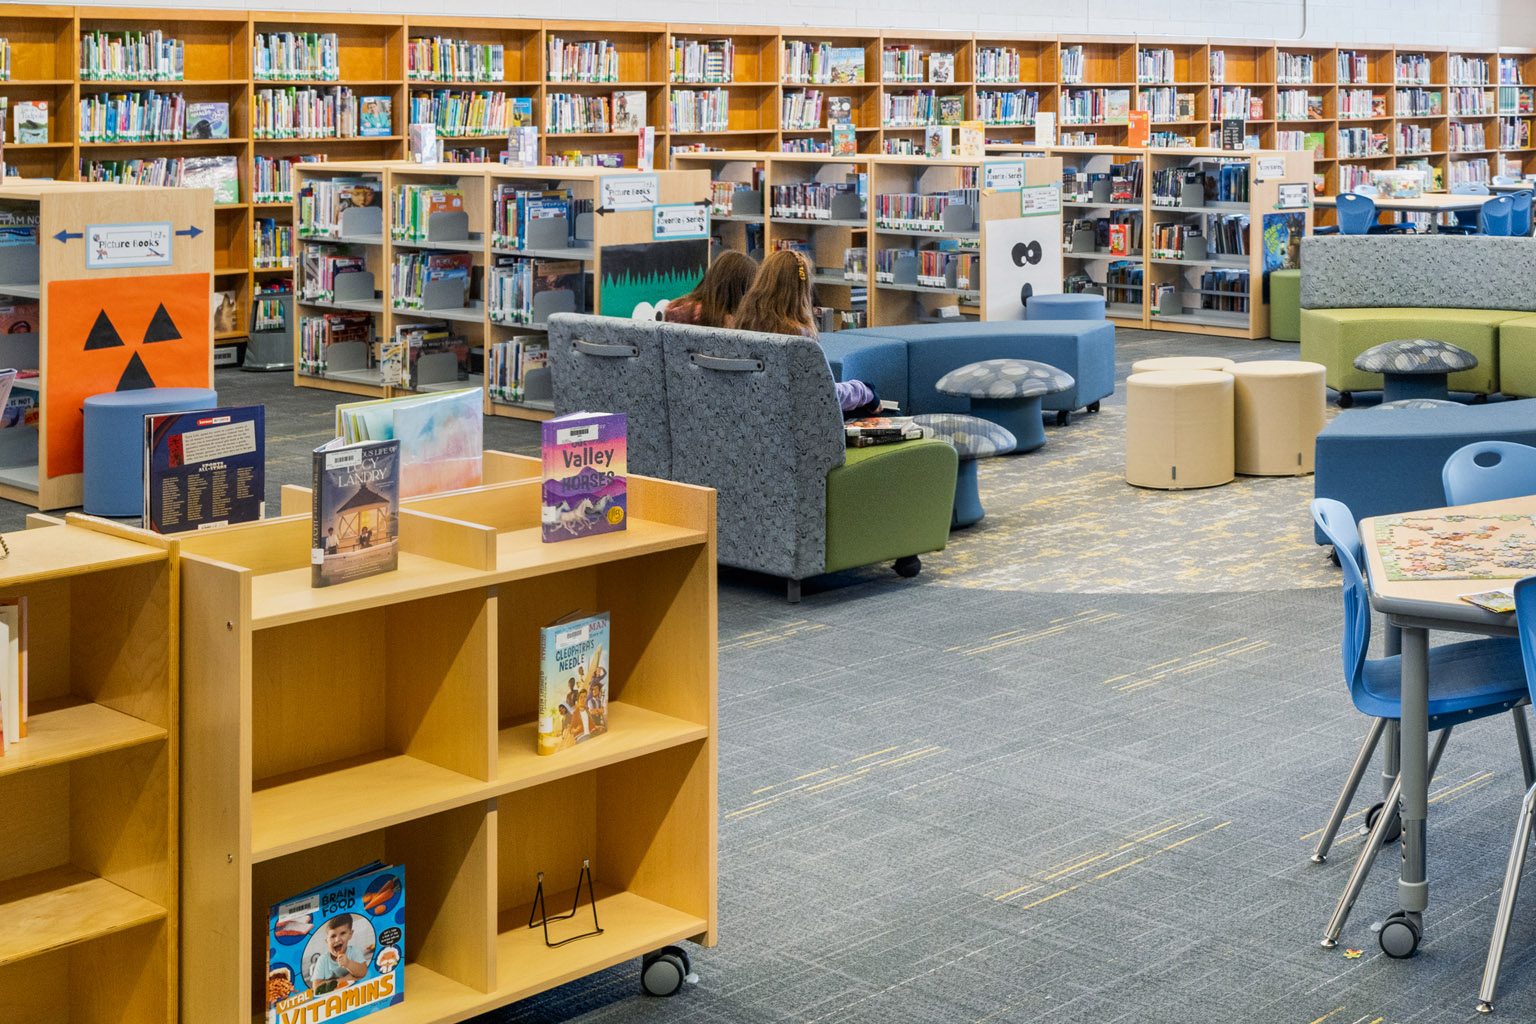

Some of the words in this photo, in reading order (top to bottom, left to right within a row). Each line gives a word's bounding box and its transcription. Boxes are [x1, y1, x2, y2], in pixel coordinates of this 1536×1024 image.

[99, 240, 130, 249] Picture
[133, 239, 159, 248] Books
[562, 447, 614, 468] Valley
[338, 467, 387, 488] LANDRY
[562, 471, 616, 492] HORSES
[555, 639, 595, 662] CLEOPATRA'S
[559, 653, 585, 672] NEEDLE
[322, 887, 356, 906] BRAIN
[322, 898, 356, 918] FOOD
[278, 992, 310, 1011] VITAL
[281, 974, 394, 1024] VITAMINS
